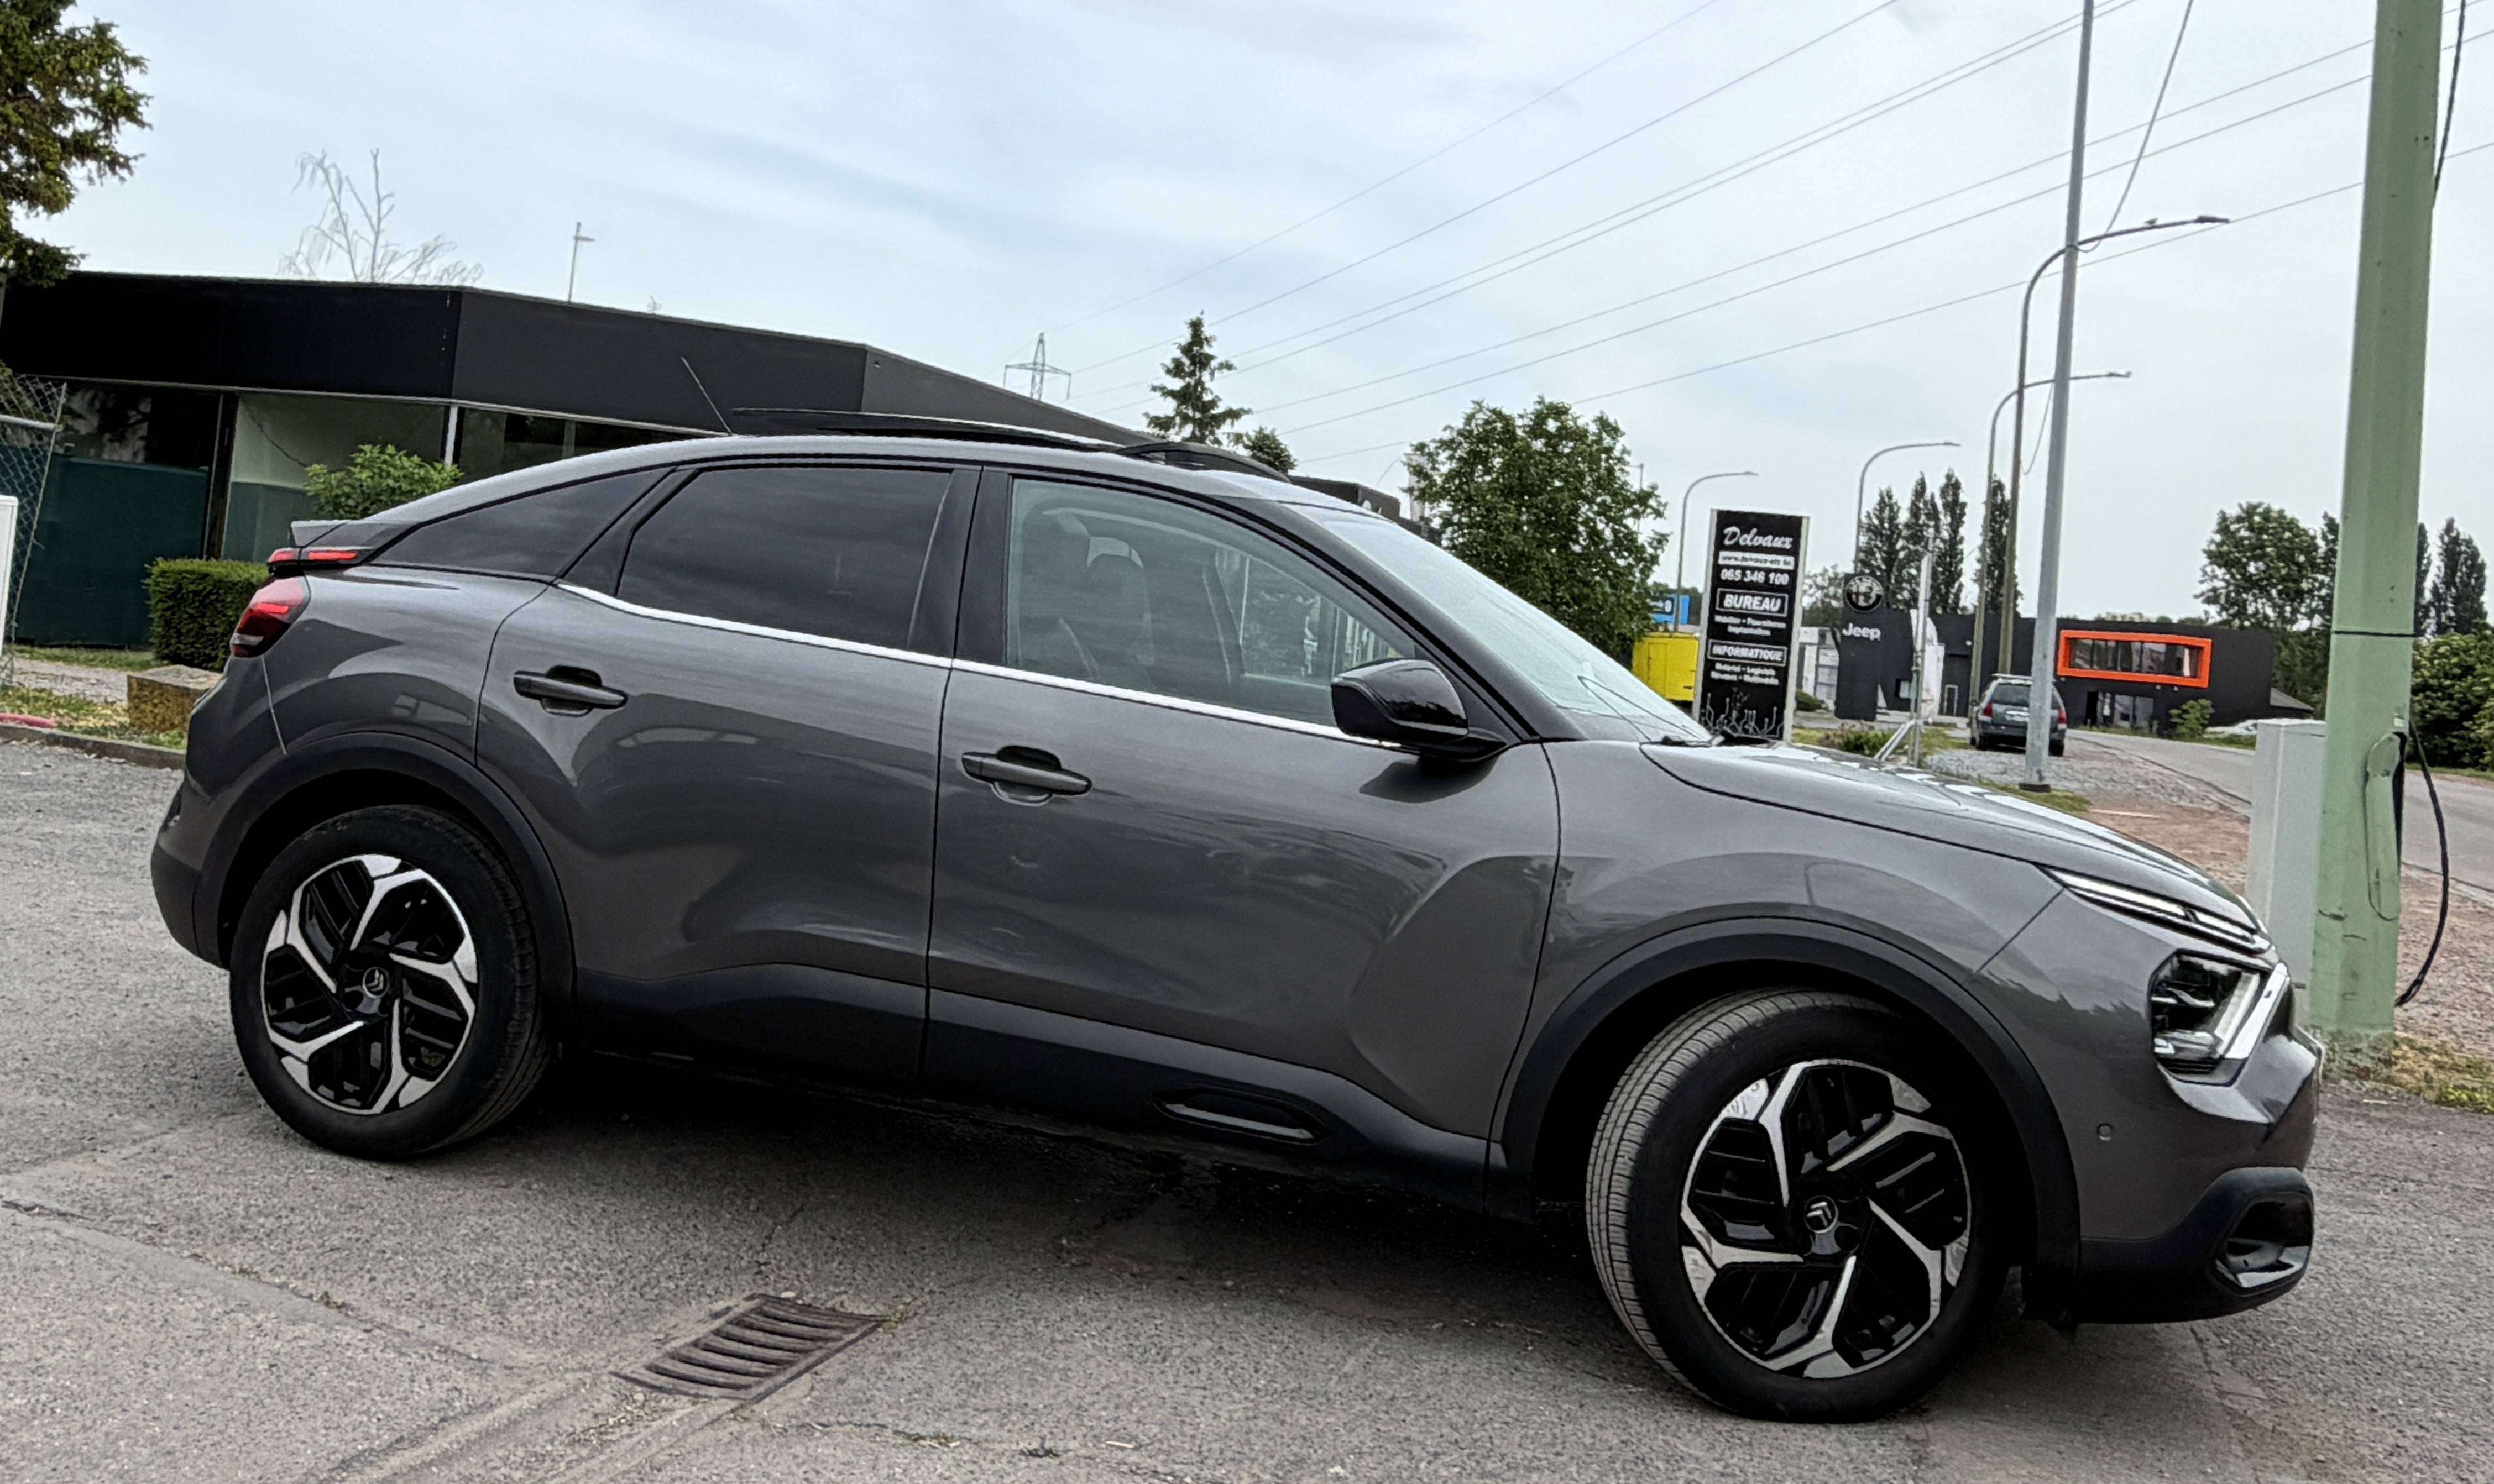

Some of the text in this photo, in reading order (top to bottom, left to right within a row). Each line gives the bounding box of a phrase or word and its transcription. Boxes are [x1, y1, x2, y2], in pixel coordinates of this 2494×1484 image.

[1723, 526, 1793, 549] Delvaux
[1720, 568, 1742, 581] 065
[1769, 571, 1790, 586] 100
[1723, 593, 1781, 612] BUREAU
[1842, 622, 1881, 641] Jeep
